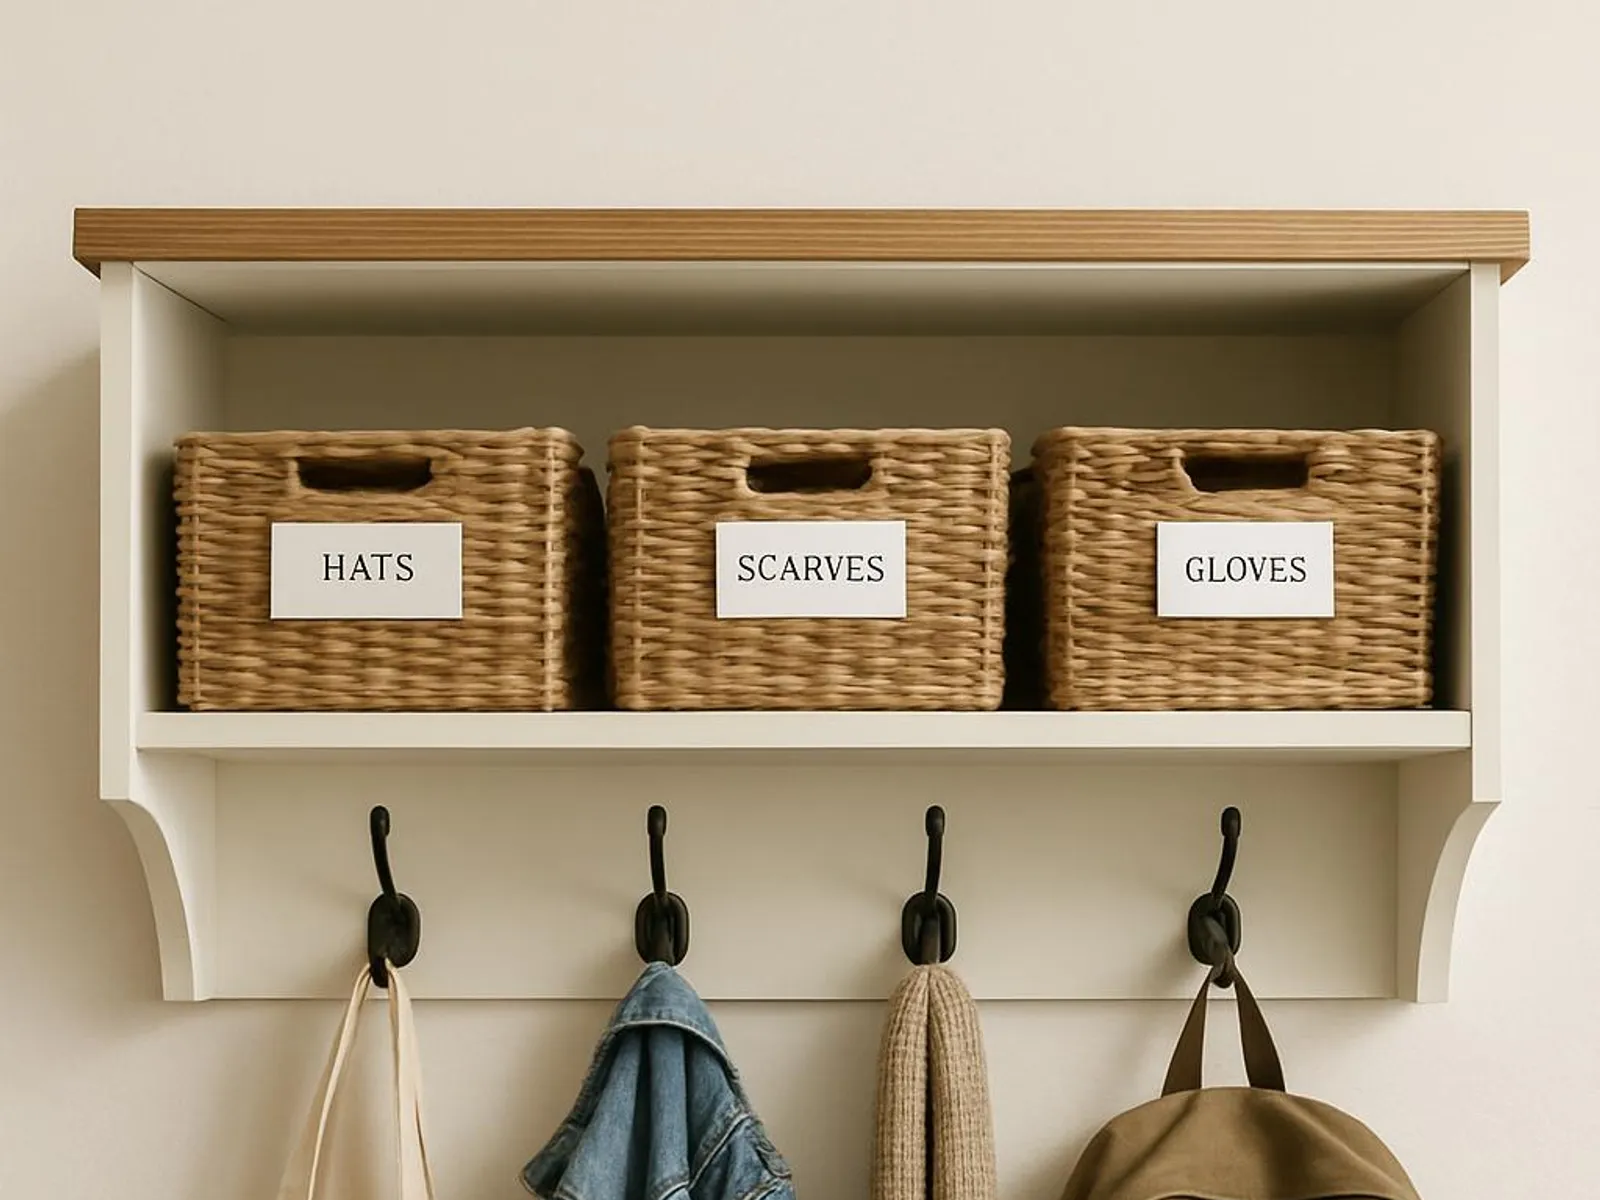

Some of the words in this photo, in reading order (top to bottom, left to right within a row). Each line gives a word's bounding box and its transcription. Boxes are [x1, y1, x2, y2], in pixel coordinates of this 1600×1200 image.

[322, 552, 415, 583] HATS
[736, 553, 885, 583] SCARVES
[1185, 555, 1307, 583] GLOVES
